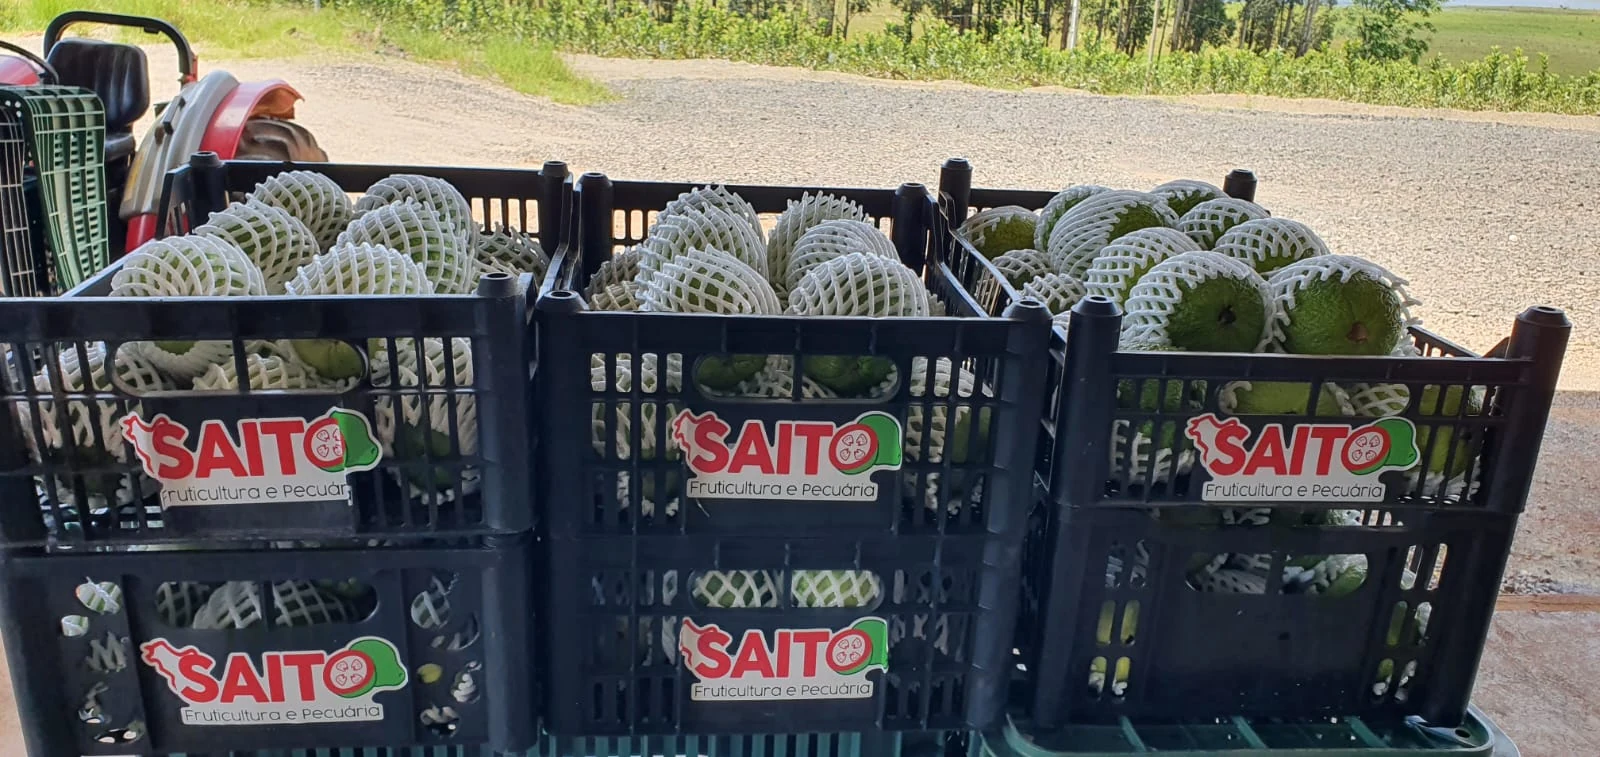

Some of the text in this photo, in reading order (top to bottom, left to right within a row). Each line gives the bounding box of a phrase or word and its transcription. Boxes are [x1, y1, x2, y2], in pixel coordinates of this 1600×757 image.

[152, 417, 346, 480] SAITO
[692, 422, 879, 475] SAITO
[1209, 426, 1391, 476] SAITO
[161, 481, 346, 504] Fruticultura e Pecuár
[690, 480, 876, 498] Fruticultura e Pecuária
[1206, 482, 1383, 498] Fruticultura e Pecuária
[695, 628, 873, 679] SAITO
[178, 649, 375, 703] SAITO
[694, 682, 871, 698] Fruticultura e Pecuária
[185, 705, 381, 722] Fruticultura e Pecuária
